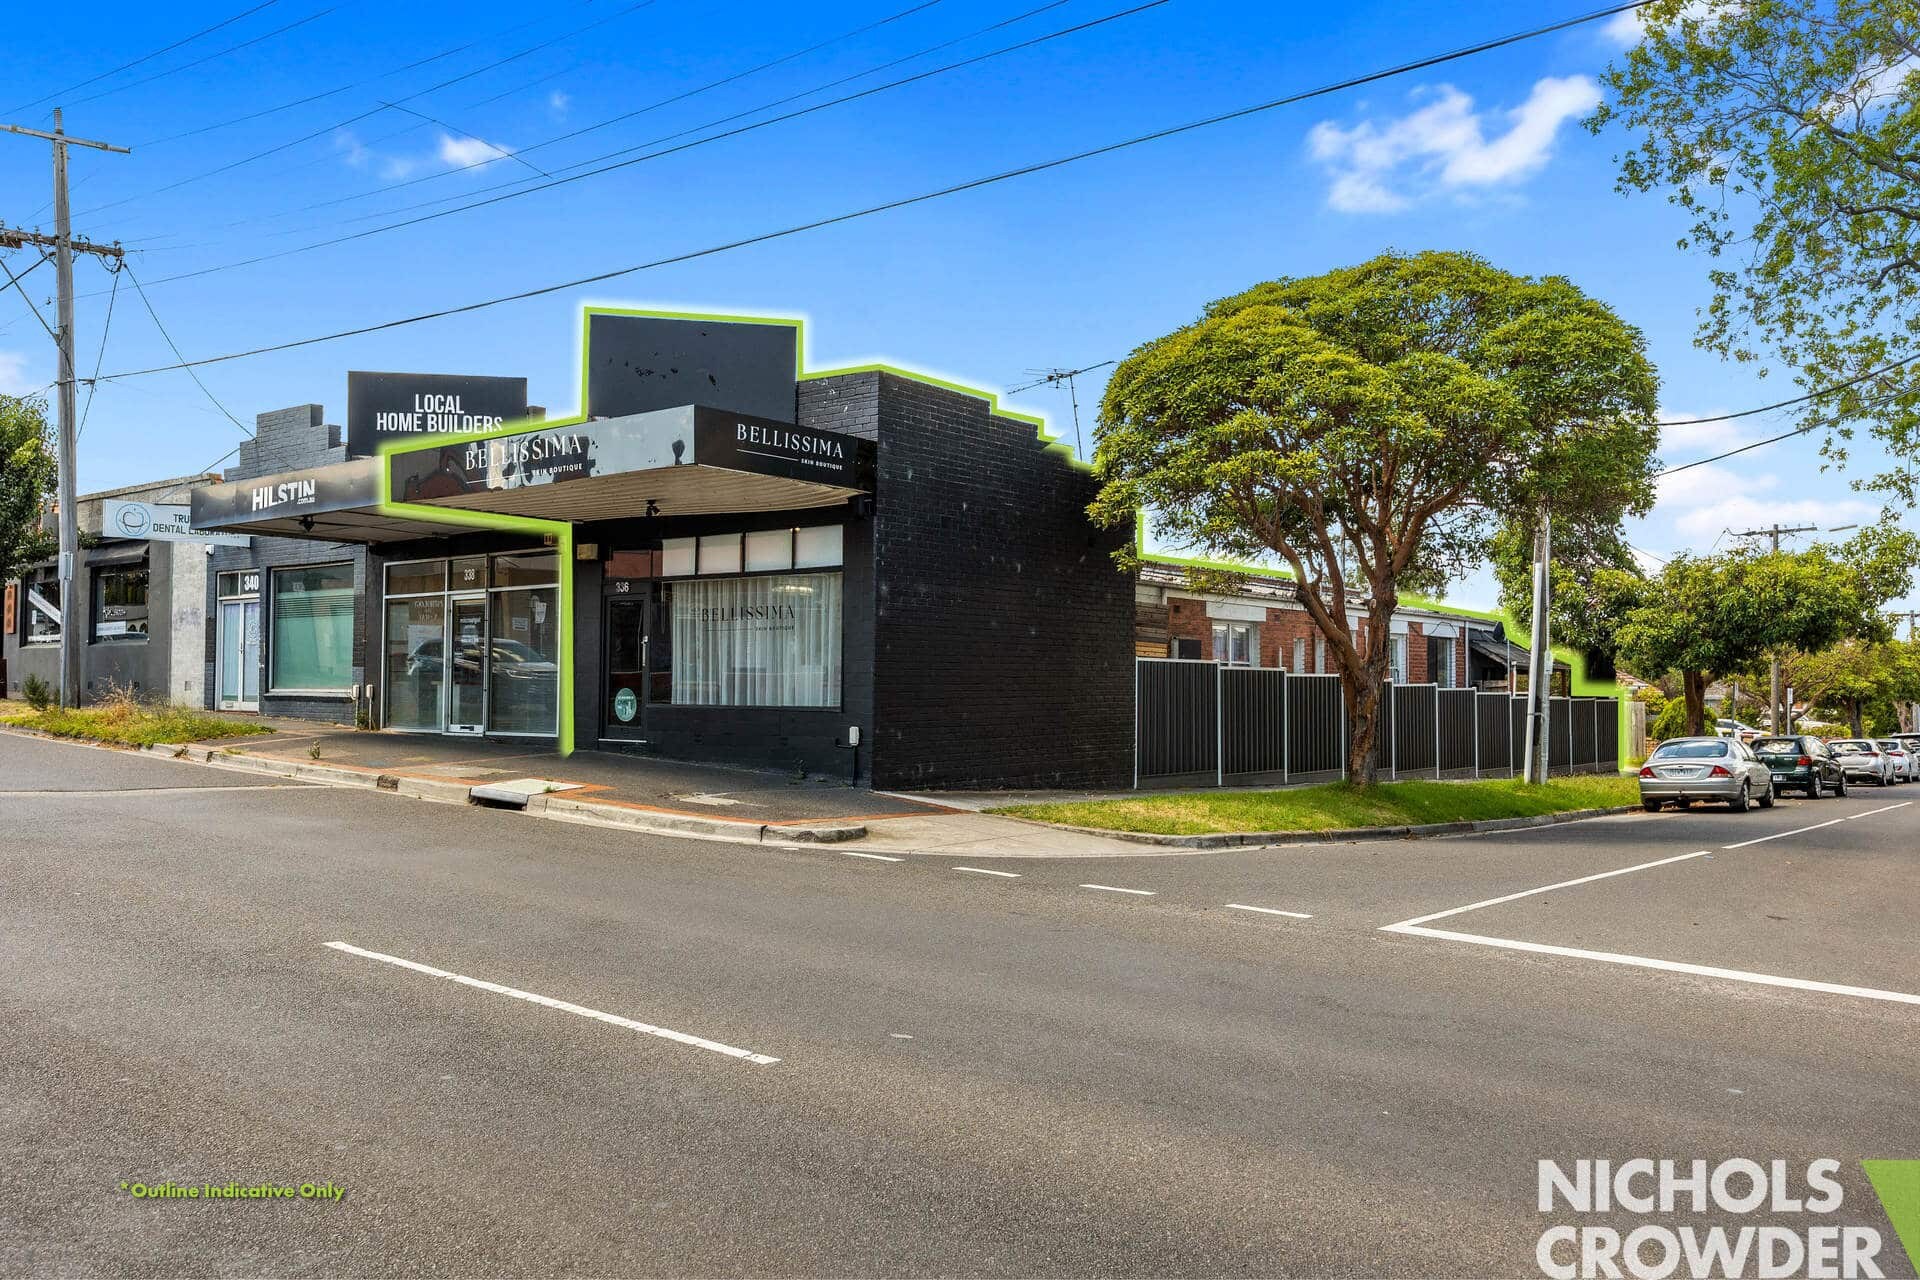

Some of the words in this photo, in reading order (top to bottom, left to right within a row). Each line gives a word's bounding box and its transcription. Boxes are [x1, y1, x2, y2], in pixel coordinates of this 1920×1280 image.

[415, 394, 464, 414] LOCAL
[376, 412, 422, 432] HOME
[427, 414, 503, 434] BUILDERS
[737, 423, 843, 459] BELLISSIMA
[466, 433, 582, 470] BELLISSIMA
[549, 463, 582, 475] BOUTIQUE
[815, 460, 843, 471] BOUTIQUE
[252, 479, 316, 511] HILSTIN
[173, 513, 191, 524] TRU
[153, 523, 187, 535] DENTAL
[244, 574, 260, 591] 340
[464, 569, 475, 581] 338
[616, 581, 630, 593] 336
[702, 604, 795, 622] BELLISSIMA
